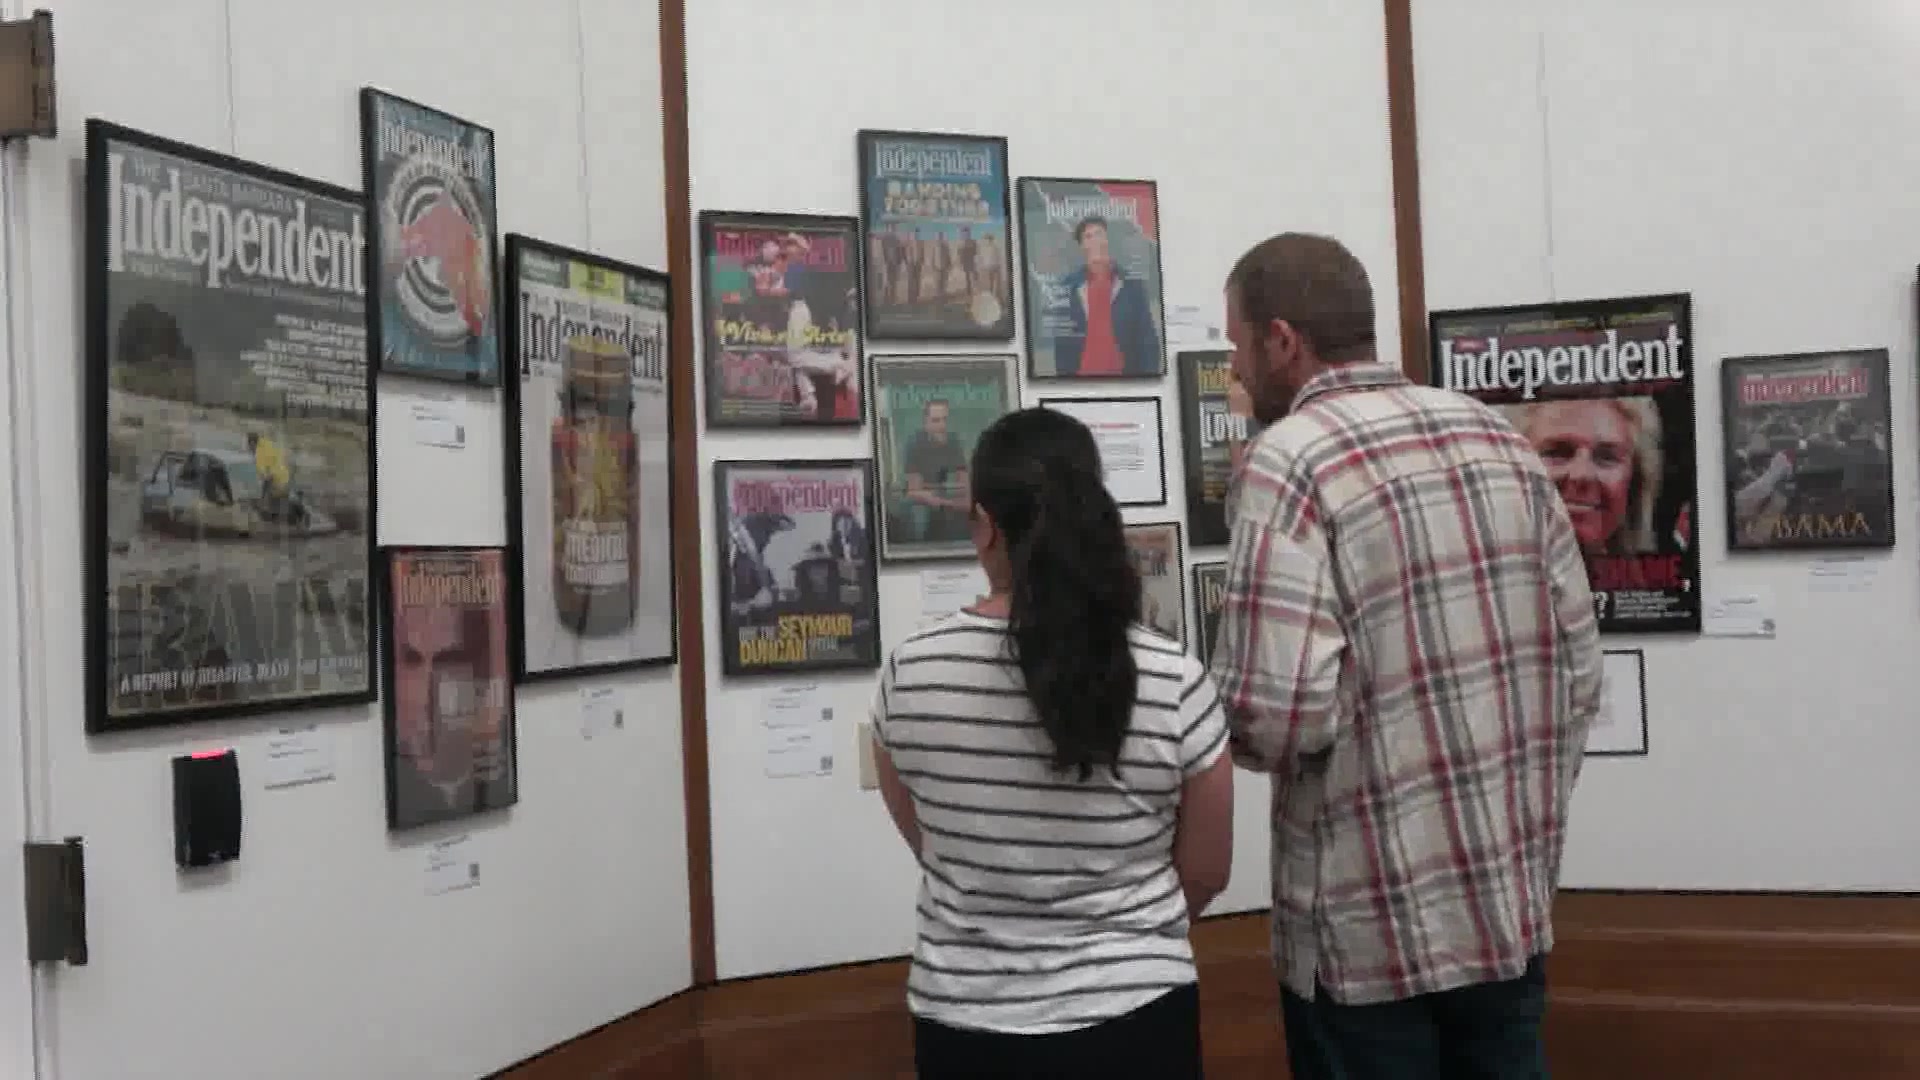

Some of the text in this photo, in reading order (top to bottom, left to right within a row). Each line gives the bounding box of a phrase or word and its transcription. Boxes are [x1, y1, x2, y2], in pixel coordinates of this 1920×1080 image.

[876, 141, 992, 180] Independent
[109, 153, 367, 288] Independent
[521, 292, 663, 380] Independent
[1441, 324, 1685, 400] Independent
[740, 638, 807, 666] DUNCAN
[778, 614, 853, 638] SEYMOUR
